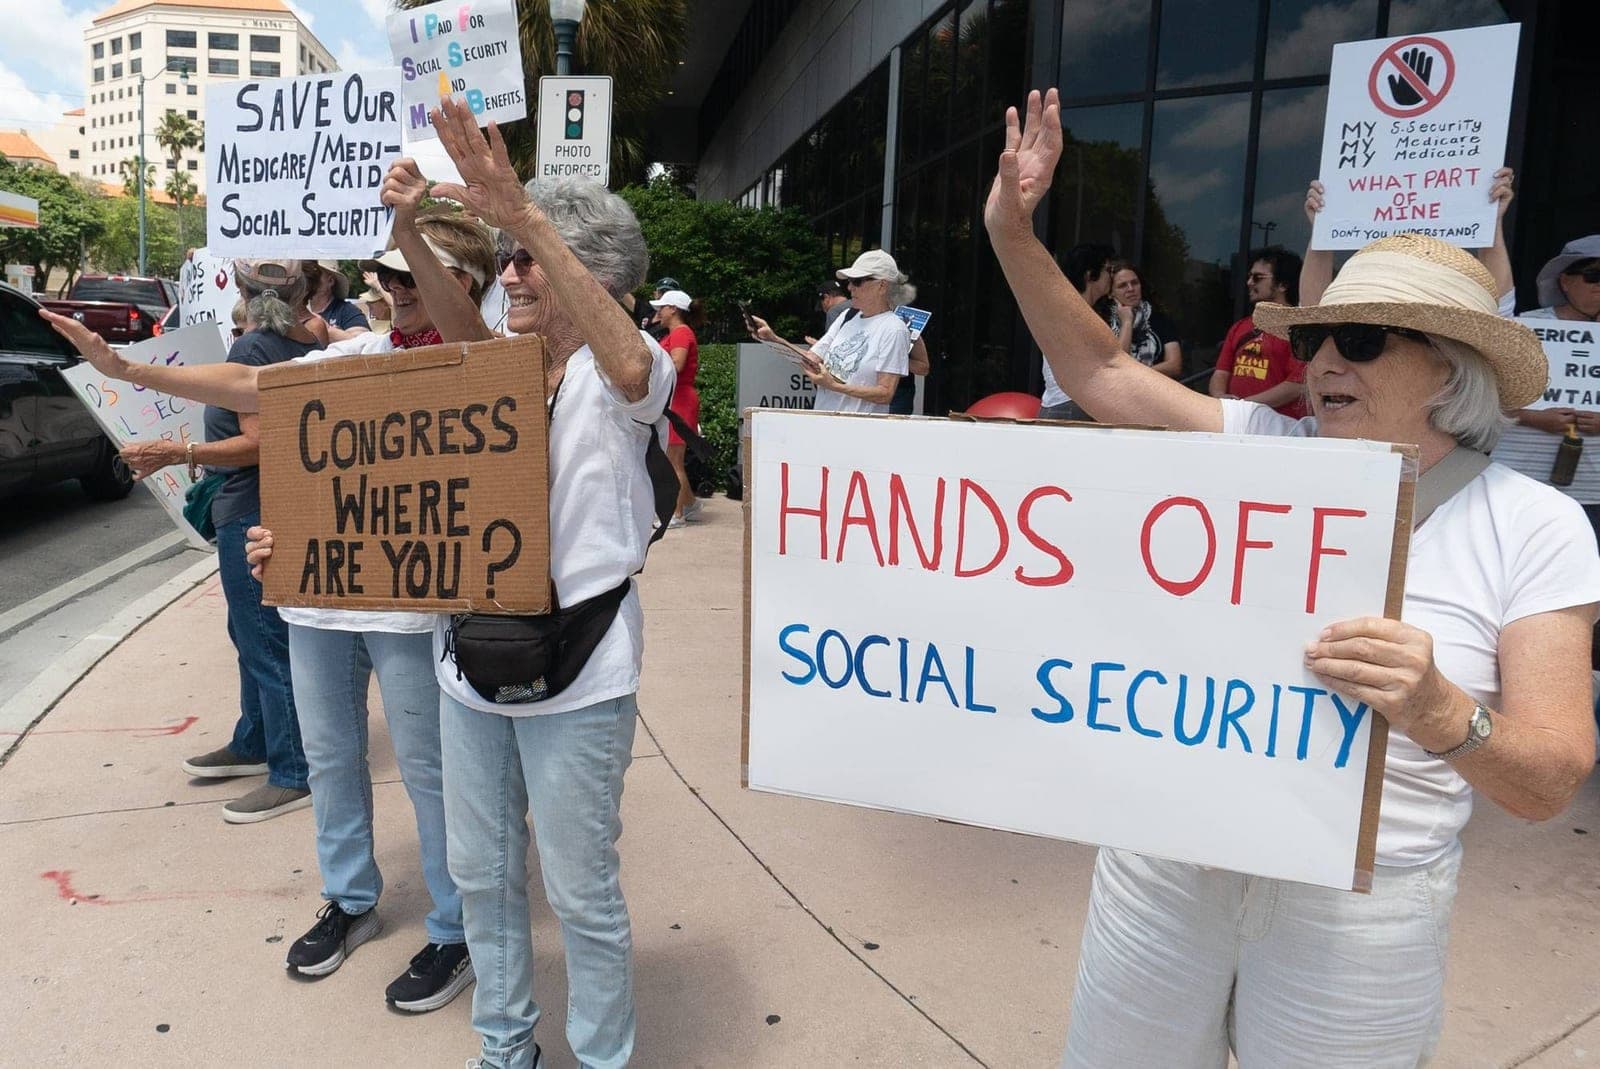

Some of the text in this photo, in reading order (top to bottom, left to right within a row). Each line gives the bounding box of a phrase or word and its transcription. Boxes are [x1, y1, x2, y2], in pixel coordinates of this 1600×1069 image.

[410, 18, 418, 43] I
[236, 79, 333, 132] SAVE
[343, 73, 397, 124] OUR
[1341, 121, 1376, 140] MY
[555, 145, 591, 158] PHOTO
[1340, 135, 1481, 155] MY Medicare
[1338, 145, 1480, 169] MY Medicaid
[544, 163, 600, 177] ENFORCED
[1348, 167, 1481, 192] WHAT PART
[1392, 192, 1417, 207] OF
[220, 193, 291, 239] SOCIAL
[1373, 202, 1440, 222] MINE
[1363, 229, 1387, 239] YOU
[1534, 327, 1594, 344] ERICA
[1565, 362, 1600, 378] RIG
[760, 395, 816, 409] ADMIN
[300, 396, 519, 473] CONGRESS
[332, 474, 470, 537] WHERE
[779, 462, 1367, 614] HANDS OFF
[299, 538, 364, 597] ARE
[778, 624, 1369, 768] SOCIAL SECURITY
